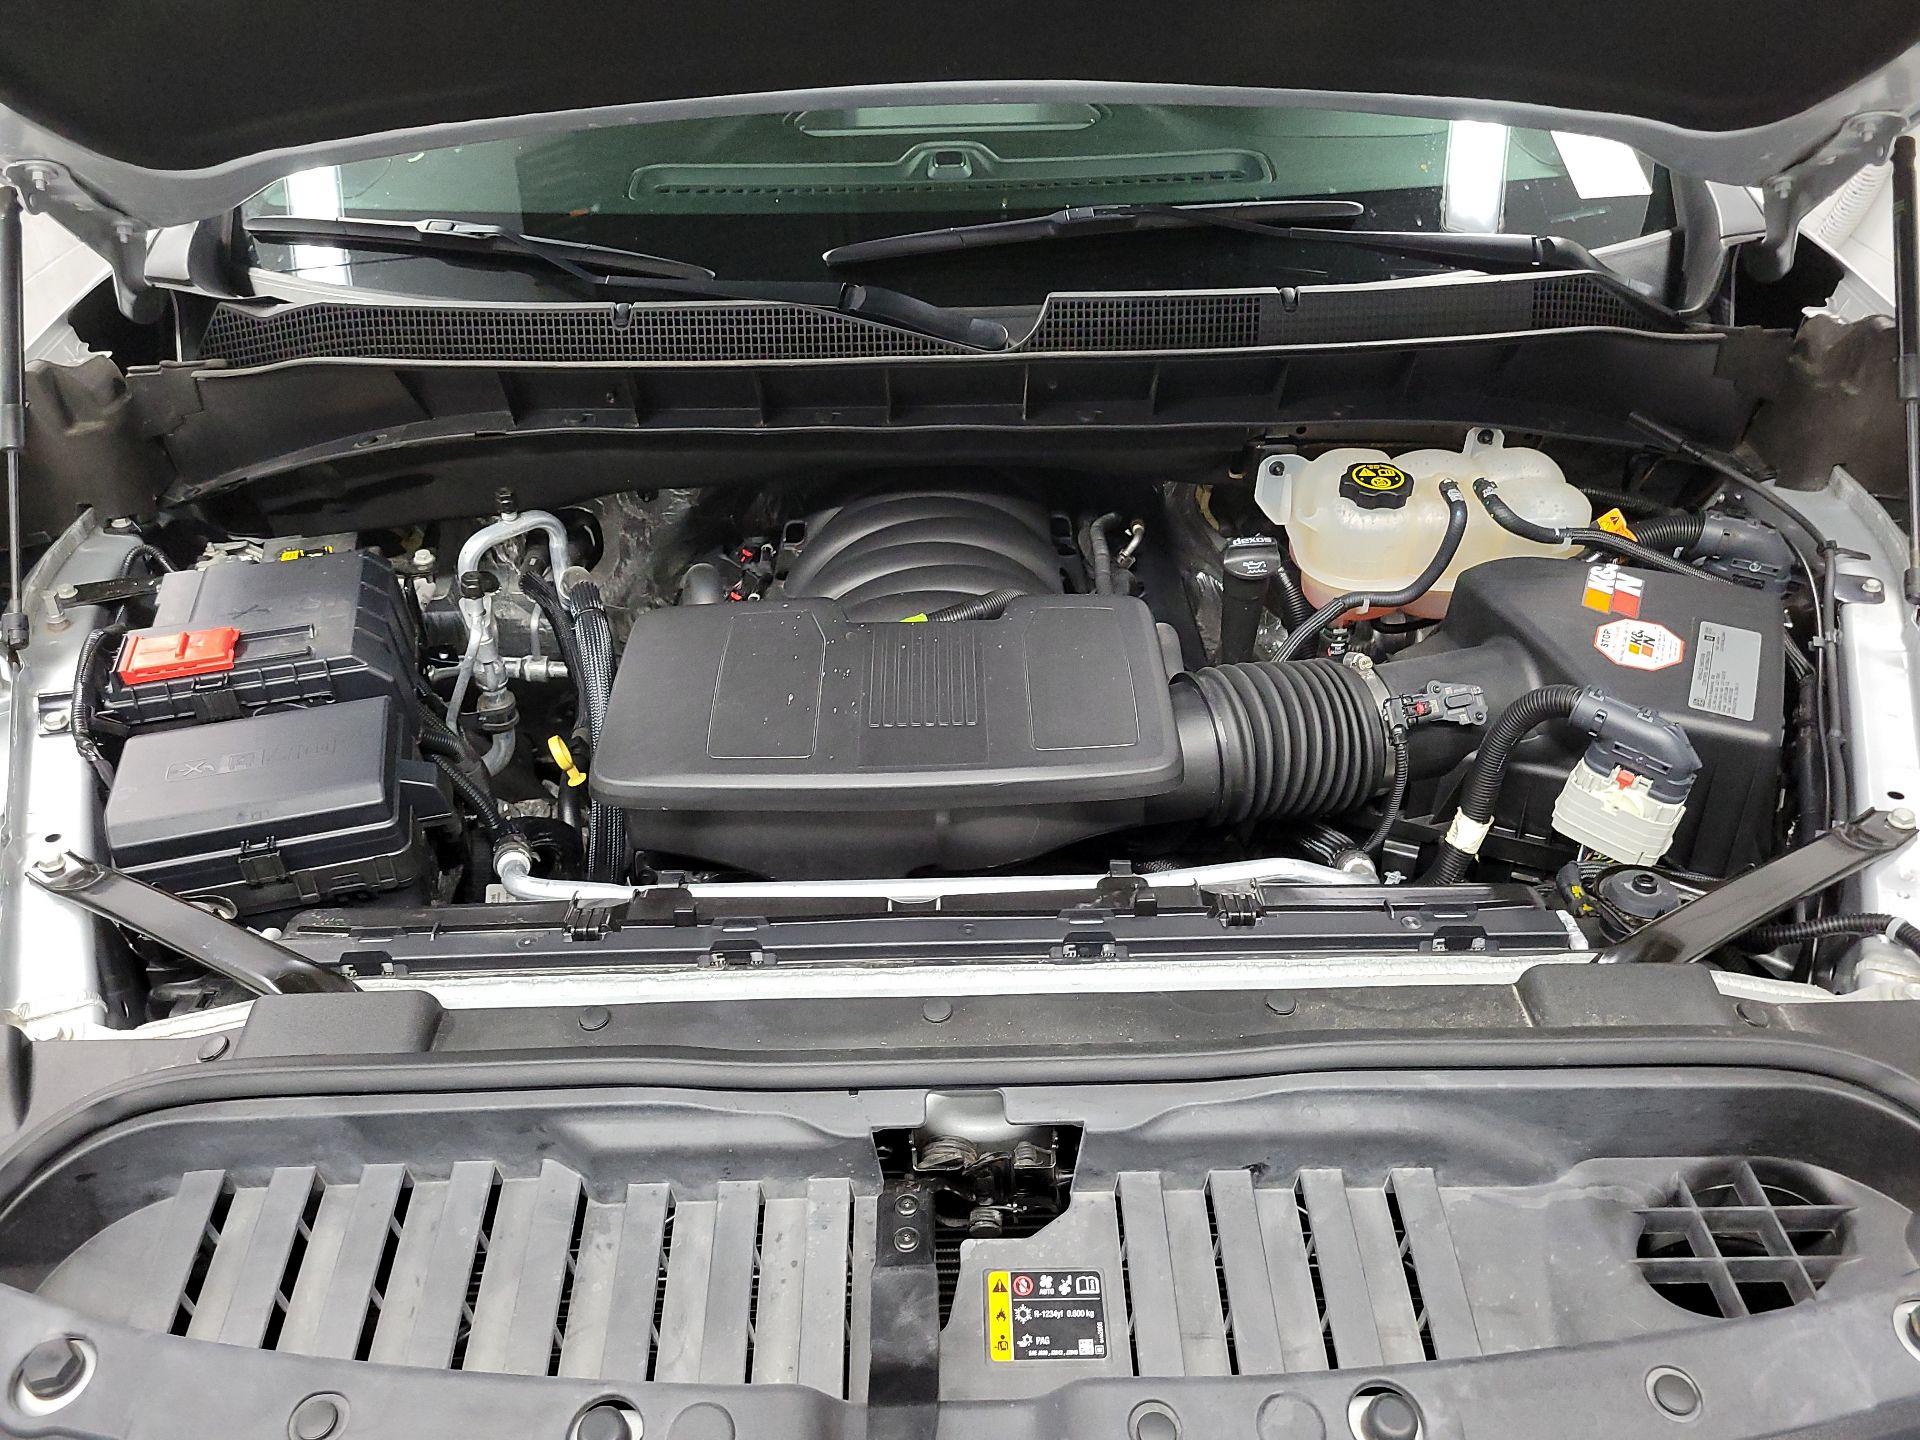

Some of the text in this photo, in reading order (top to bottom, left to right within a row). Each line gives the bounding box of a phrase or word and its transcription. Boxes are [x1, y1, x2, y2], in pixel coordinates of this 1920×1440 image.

[1232, 535, 1272, 545] dexos
[1601, 628, 1611, 648] STOP
[1085, 1309, 1095, 1319] kg
[1035, 1336, 1051, 1346] PAG
